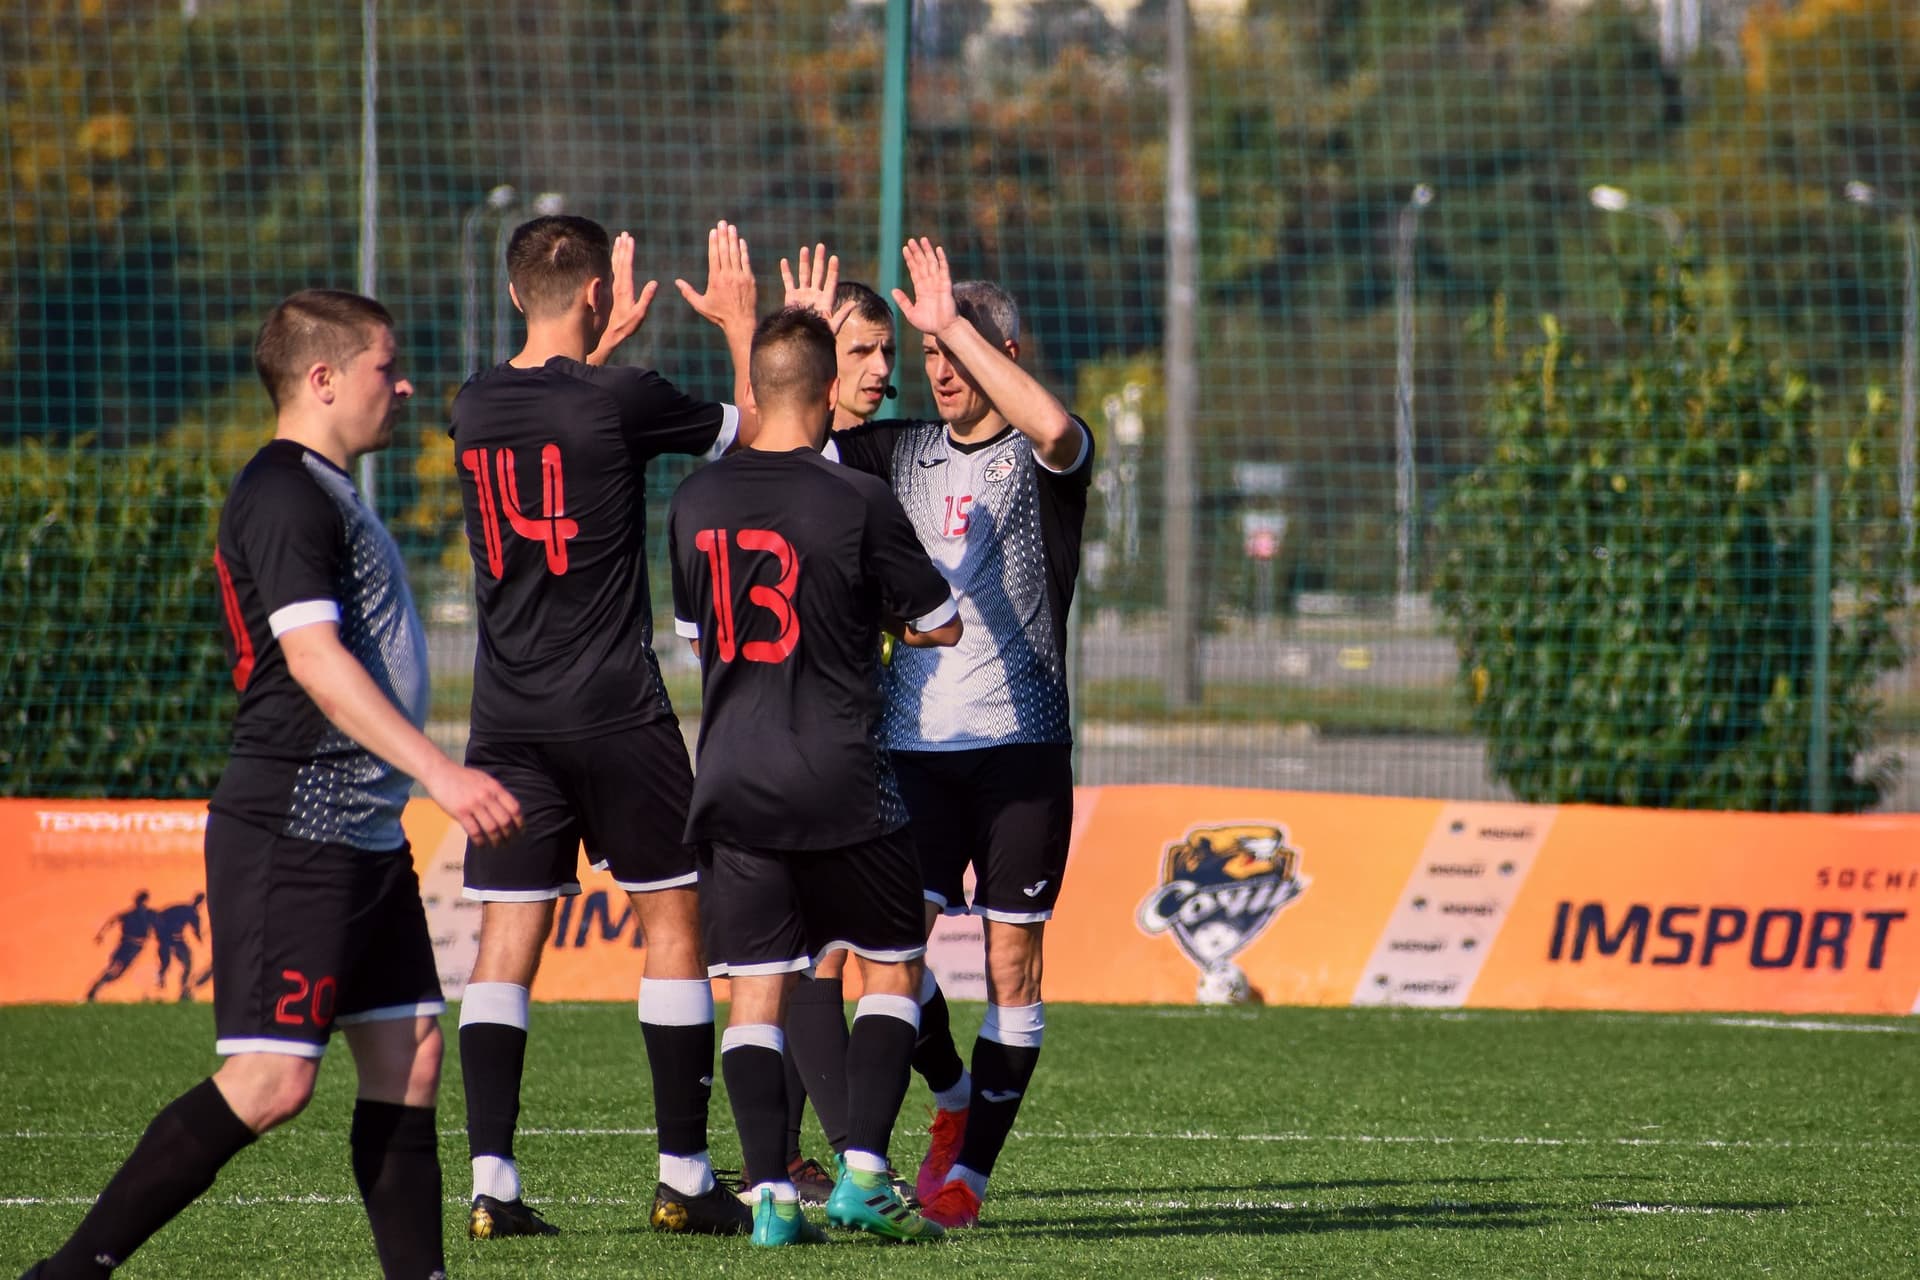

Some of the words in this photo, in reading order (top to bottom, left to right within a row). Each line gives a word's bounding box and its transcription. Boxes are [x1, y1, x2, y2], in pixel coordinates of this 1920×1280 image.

[462, 443, 579, 580] 14
[943, 494, 973, 537] 15
[695, 528, 800, 664] 13
[1547, 900, 1908, 970] IMSPORT
[275, 969, 337, 1028] 20
